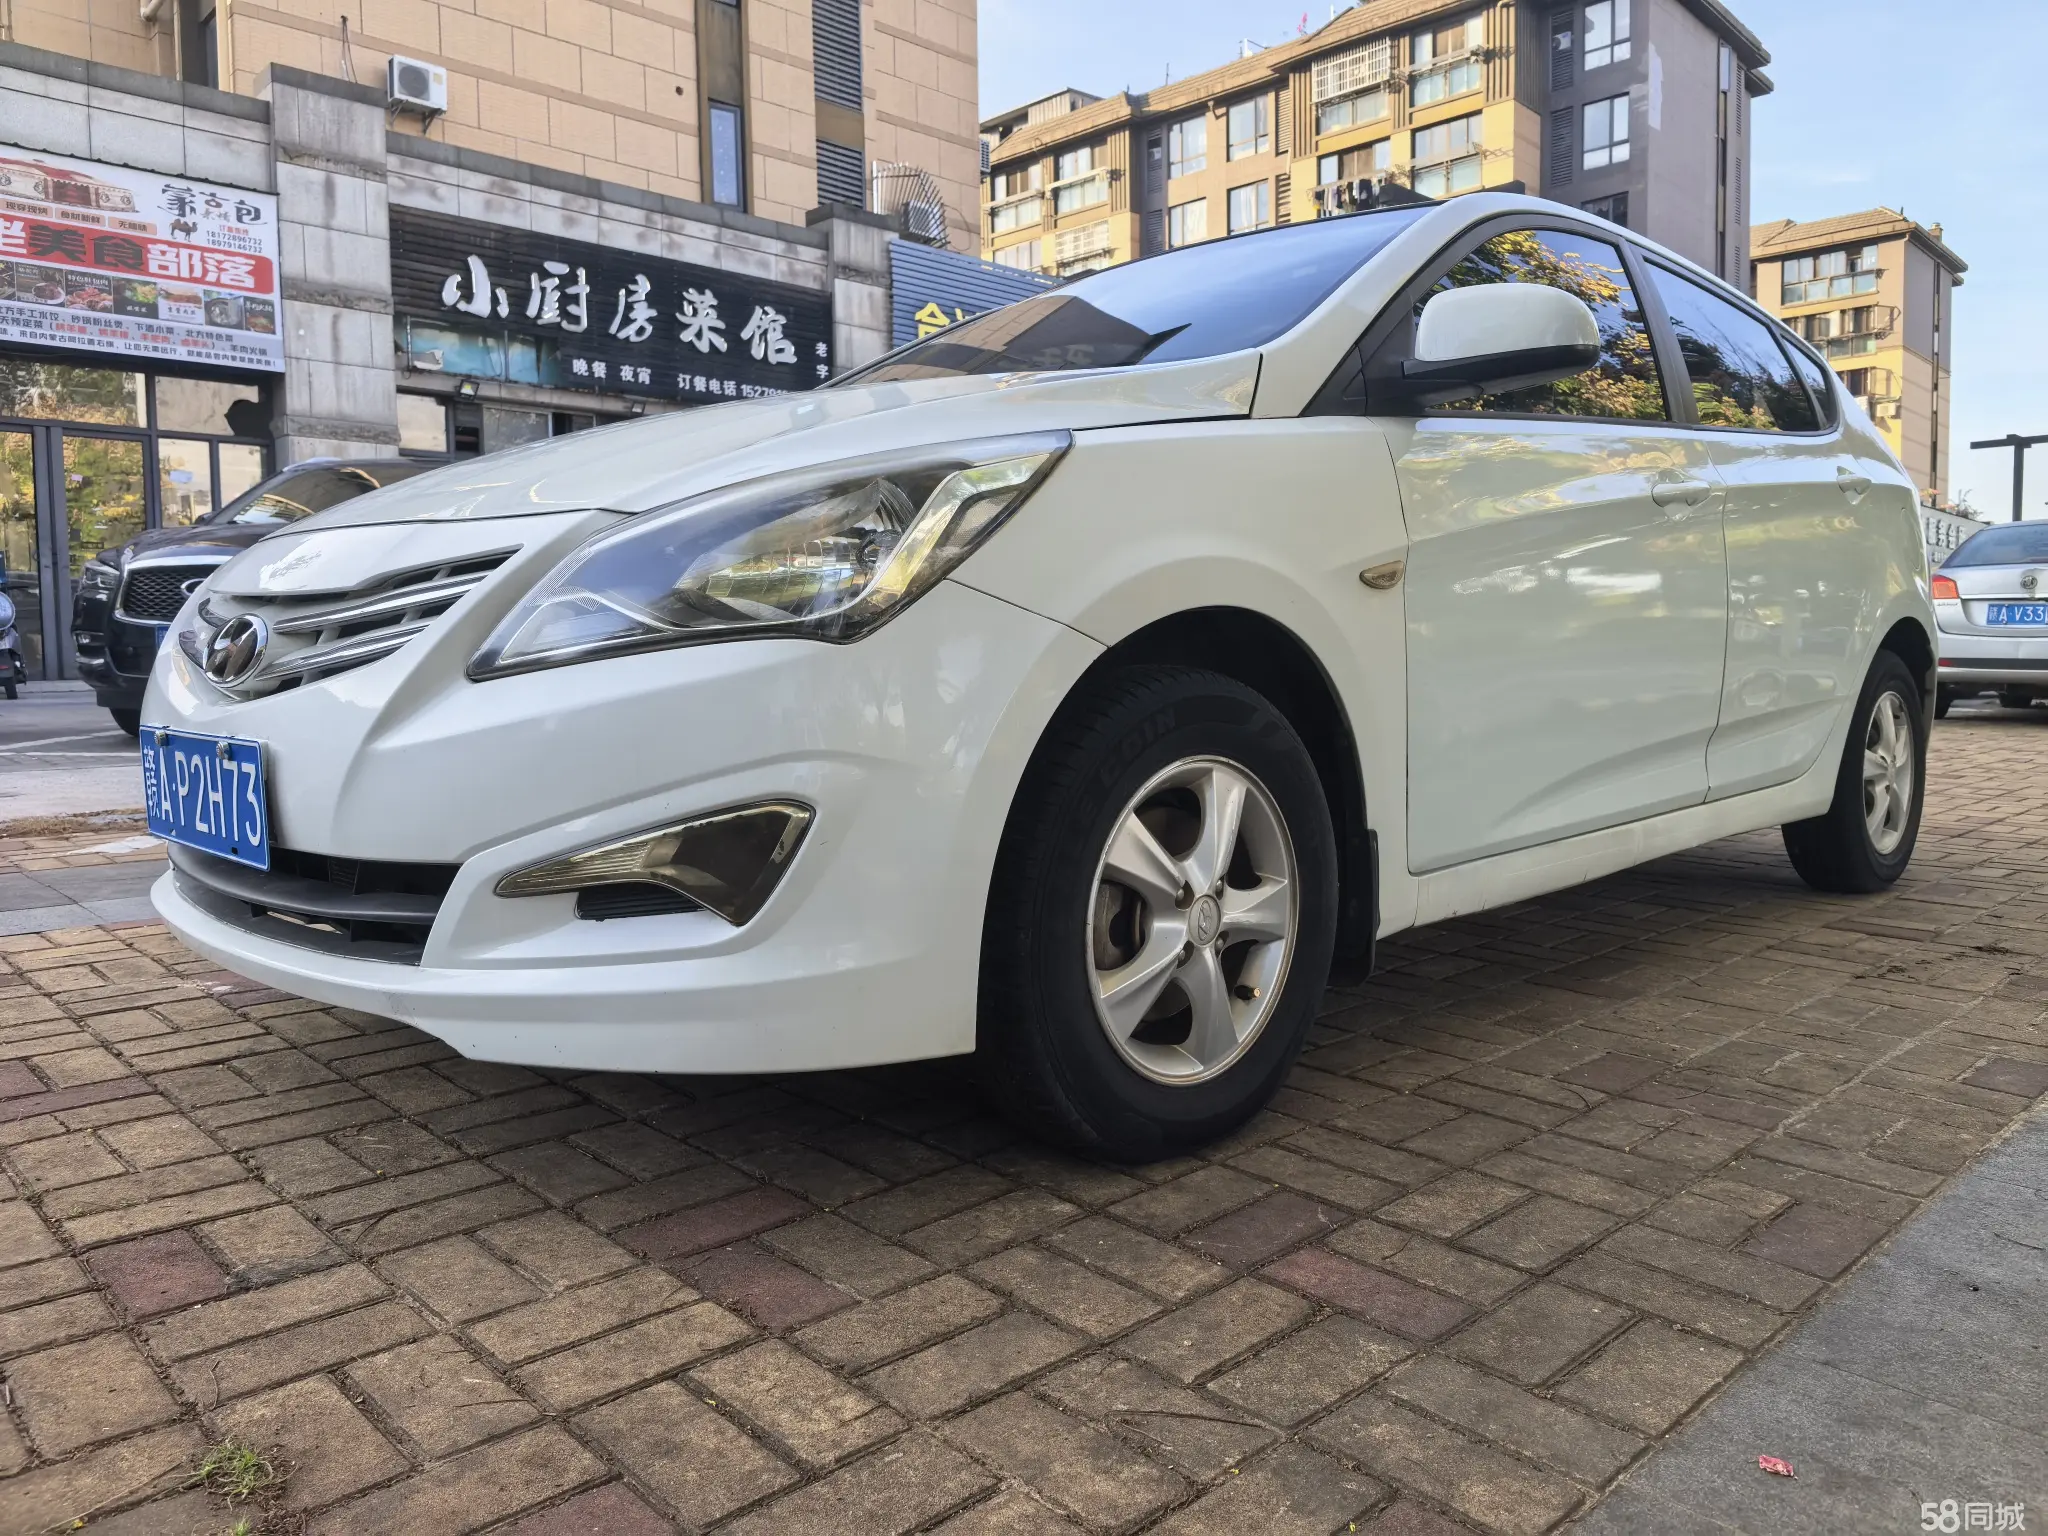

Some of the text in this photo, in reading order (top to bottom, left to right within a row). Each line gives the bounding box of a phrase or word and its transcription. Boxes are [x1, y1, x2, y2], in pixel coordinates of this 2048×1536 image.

[157, 183, 267, 226] 蒙古包
[206, 230, 263, 246] 18172896732
[207, 238, 263, 253] 18979146732
[442, 254, 797, 365] 小厨房菜馆
[572, 358, 651, 385] 晚餐 夜宵
[677, 373, 788, 398] 订餐电话 15279
[1988, 603, 2048, 624] 赣A·V33
